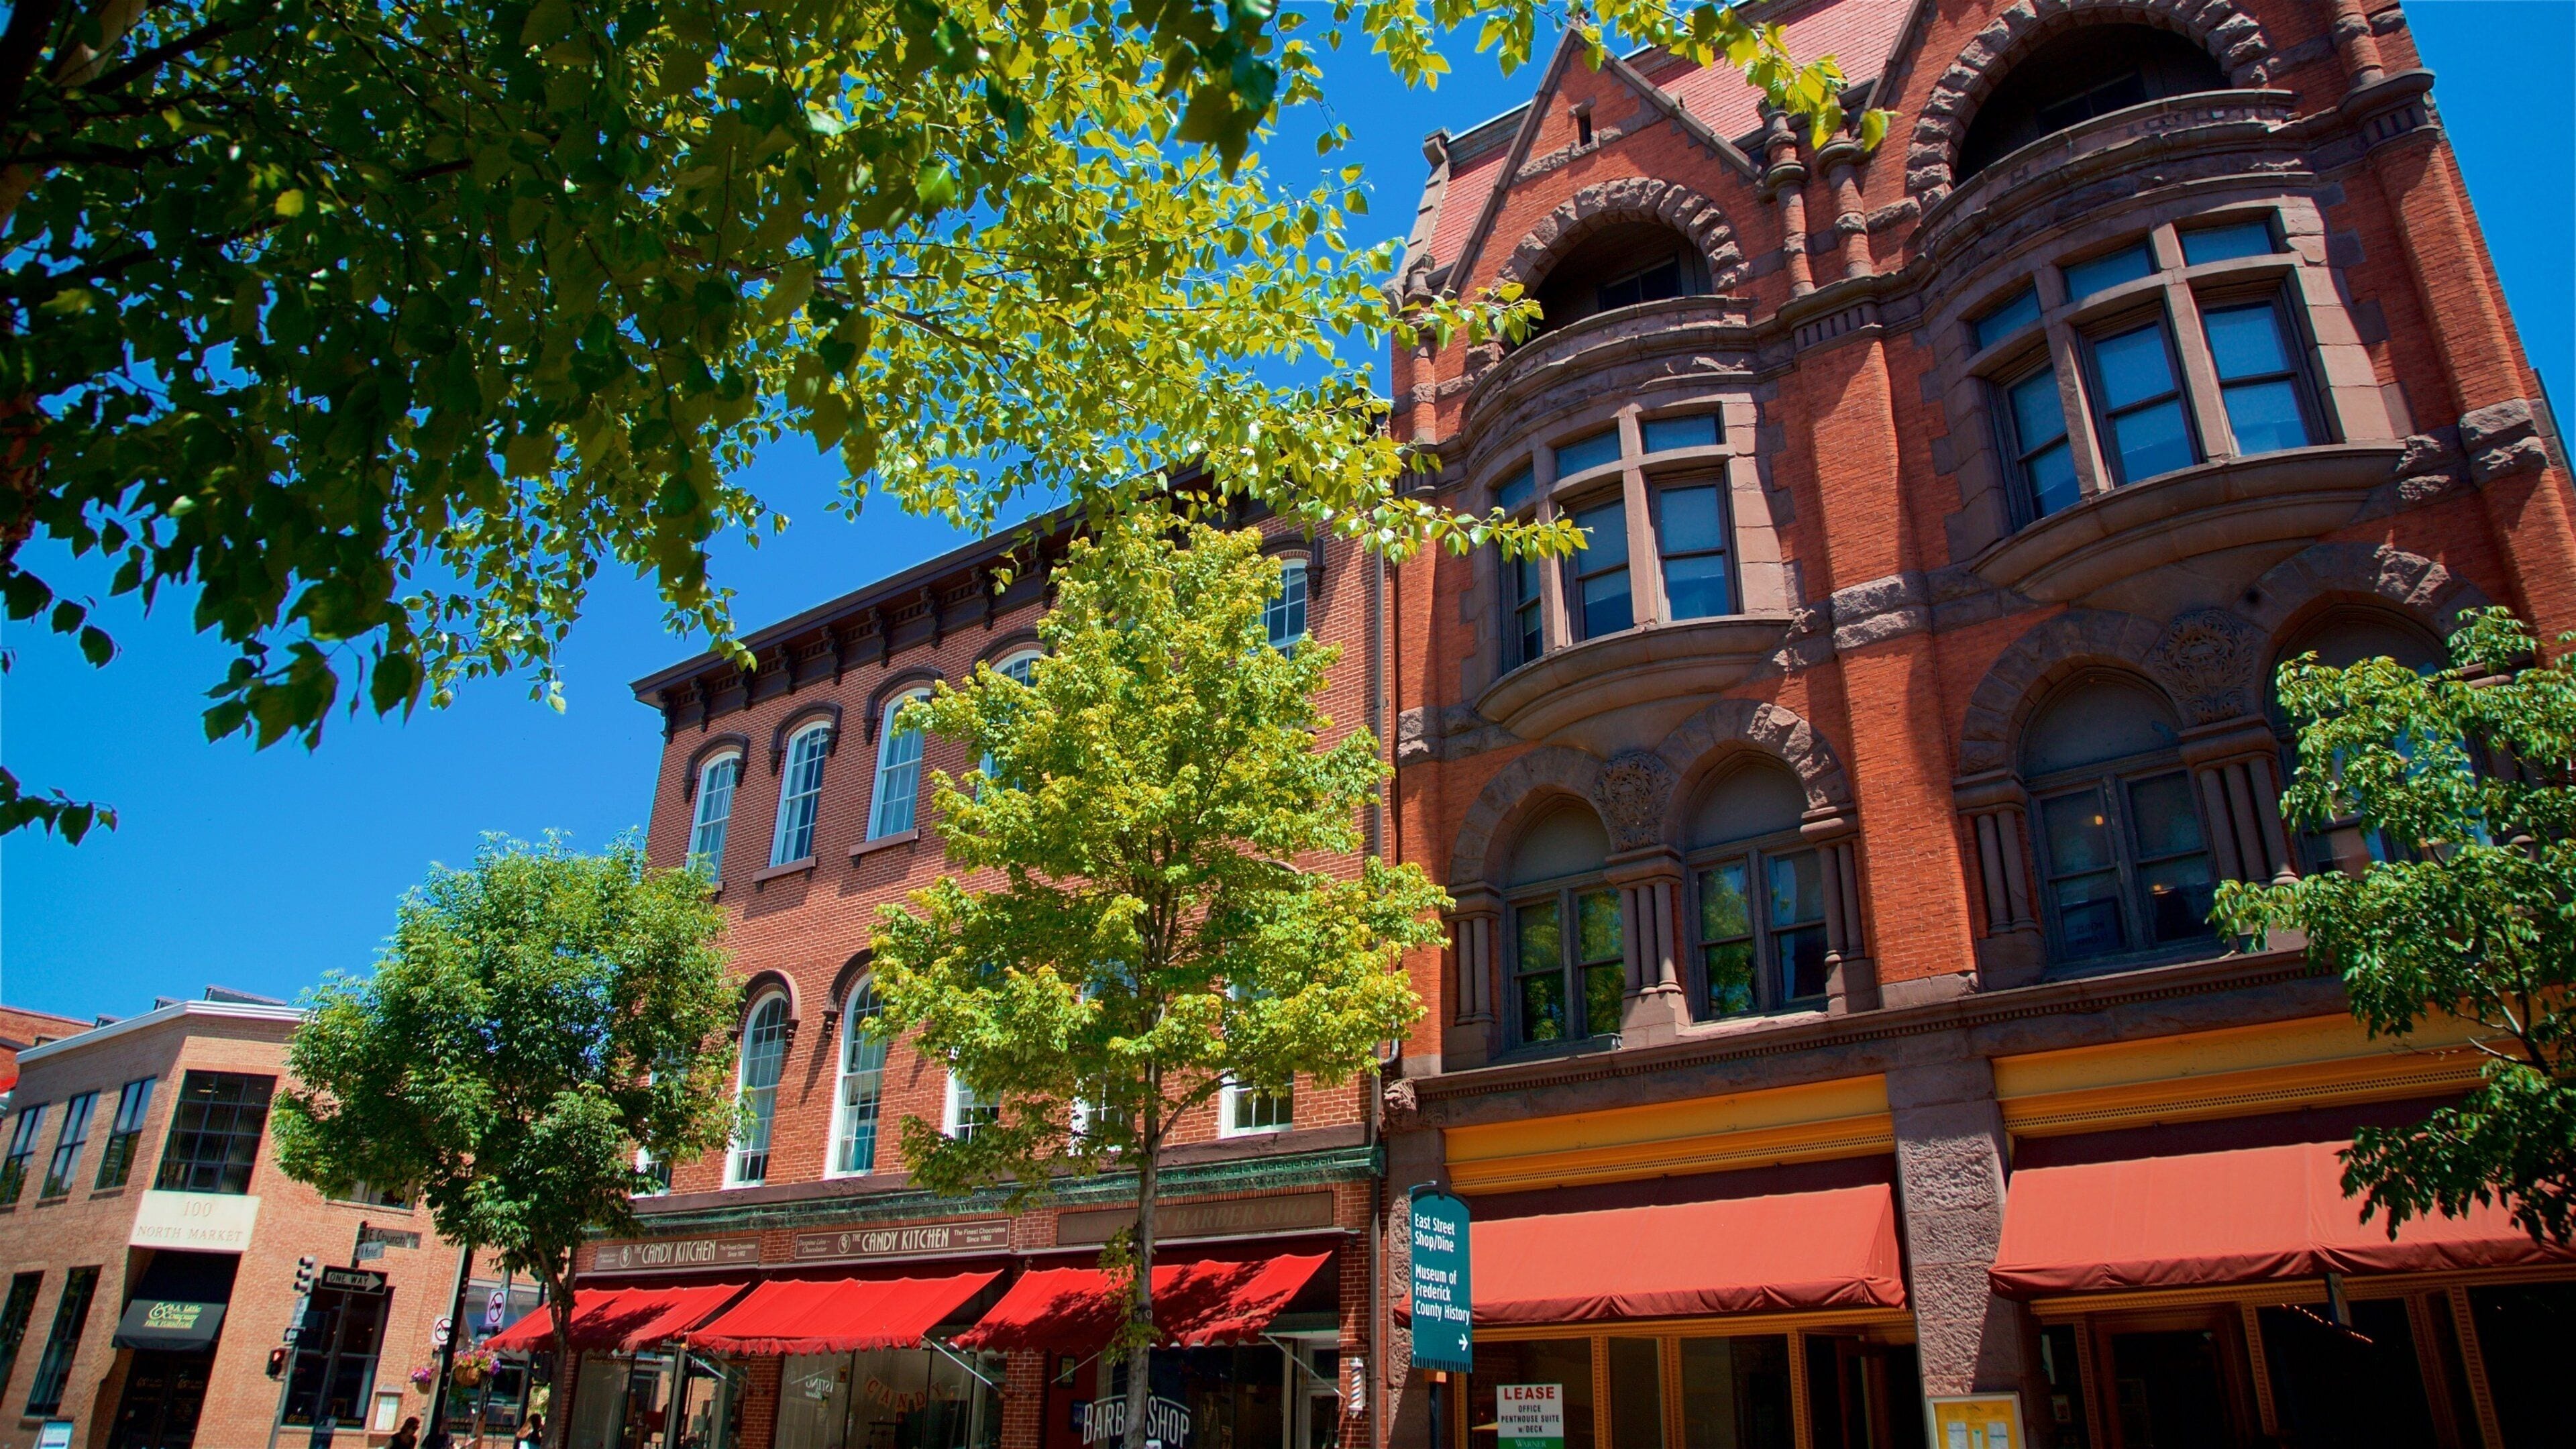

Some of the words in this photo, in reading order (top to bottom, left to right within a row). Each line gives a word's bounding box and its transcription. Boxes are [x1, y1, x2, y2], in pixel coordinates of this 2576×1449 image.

[183, 1201, 213, 1217] 100
[1175, 1205, 1256, 1231] BARBER
[1261, 1199, 1323, 1225] SHOP
[136, 1226, 182, 1239] NORTH
[187, 1228, 244, 1242] MARKET
[1414, 1213, 1431, 1230] East
[1432, 1218, 1455, 1236] Street
[376, 1229, 406, 1245] Church
[852, 1233, 861, 1242] THE
[861, 1230, 898, 1252] CANDY
[902, 1228, 949, 1250] KITCHEN
[1415, 1230, 1454, 1253] Shop/Dine
[633, 1244, 643, 1254] THE
[642, 1242, 674, 1265] CANDY
[675, 1240, 716, 1265] KITCHEN
[329, 1273, 346, 1283] ONE
[351, 1275, 370, 1285] WAY
[1415, 1264, 1447, 1283] Museum
[1448, 1270, 1457, 1285] of
[1415, 1282, 1451, 1301] Frederick
[1415, 1300, 1442, 1322] County
[1444, 1304, 1470, 1326] History
[867, 1379, 941, 1407] CANDY
[1504, 1387, 1555, 1400] LEASE
[1501, 1415, 1538, 1423] PENTHOUSE
[1540, 1415, 1560, 1423] SUITE
[1518, 1405, 1541, 1413] OFFICE
[1083, 1401, 1126, 1446] BARB
[1147, 1395, 1190, 1448] SHOP
